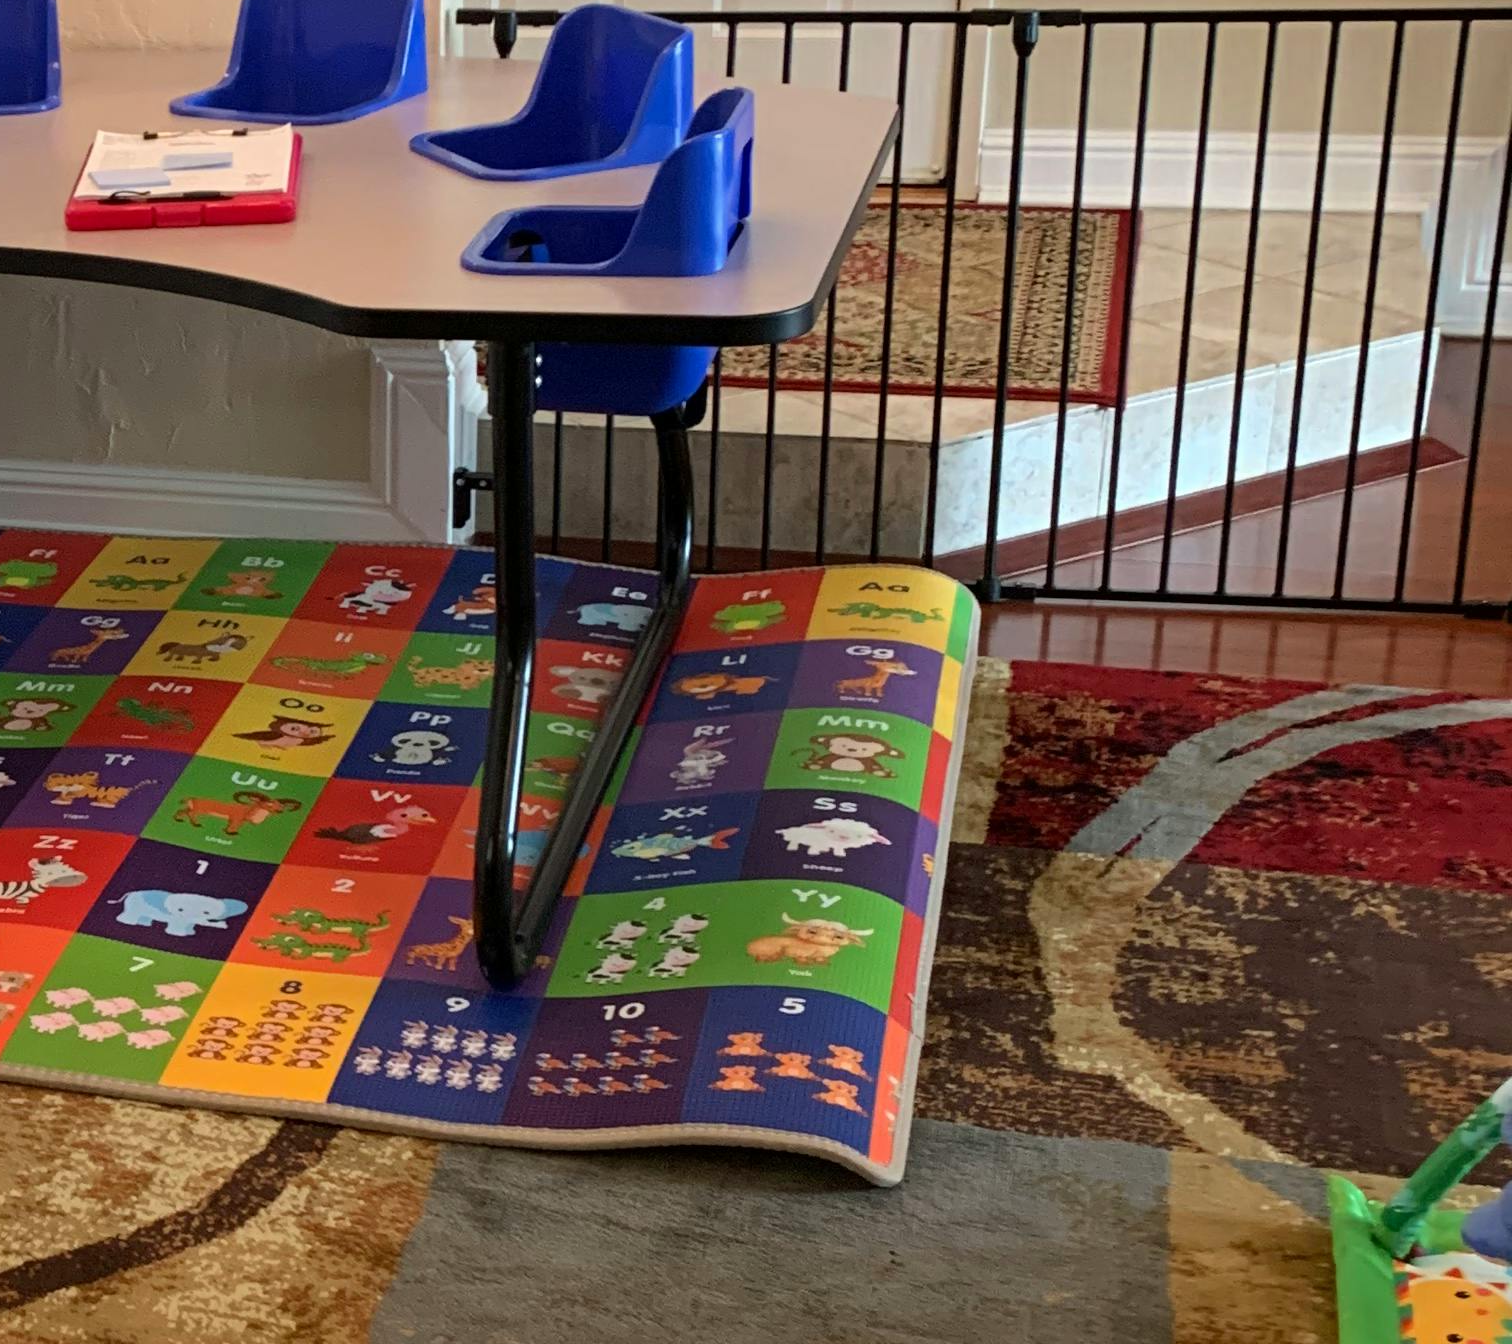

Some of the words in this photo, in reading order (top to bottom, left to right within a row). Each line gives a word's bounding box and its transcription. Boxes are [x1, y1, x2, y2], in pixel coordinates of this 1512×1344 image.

[28, 548, 59, 559] Ff
[124, 555, 172, 565] Aa
[240, 556, 285, 569] Bb
[364, 565, 403, 578] Cc
[610, 586, 648, 601] Ee
[741, 588, 774, 602] Ff
[858, 582, 911, 593] Aa
[79, 615, 122, 629] Gg
[197, 617, 242, 631] Hh
[455, 641, 483, 656] Jj
[845, 644, 895, 660] Gg
[581, 651, 624, 667] Kk
[720, 653, 748, 667] Ll
[14, 679, 76, 695] Mm
[147, 681, 194, 694] Nn
[278, 696, 326, 714] Oo
[408, 710, 453, 728] Pp
[816, 713, 890, 733] Mm
[692, 724, 732, 740] Rr
[104, 753, 136, 767] Tt
[230, 770, 280, 792] Uu
[369, 788, 413, 804] Vv
[812, 796, 859, 814] Ss
[658, 805, 710, 822] Xx
[32, 834, 79, 851] Zz
[194, 858, 210, 876] 1
[330, 877, 357, 894] 2
[642, 896, 667, 912] 4
[791, 887, 843, 909] Yy
[128, 955, 156, 973] 7
[279, 980, 304, 995] 8
[444, 995, 471, 1014] 9
[601, 1001, 646, 1022] 10
[777, 996, 809, 1017] 5
